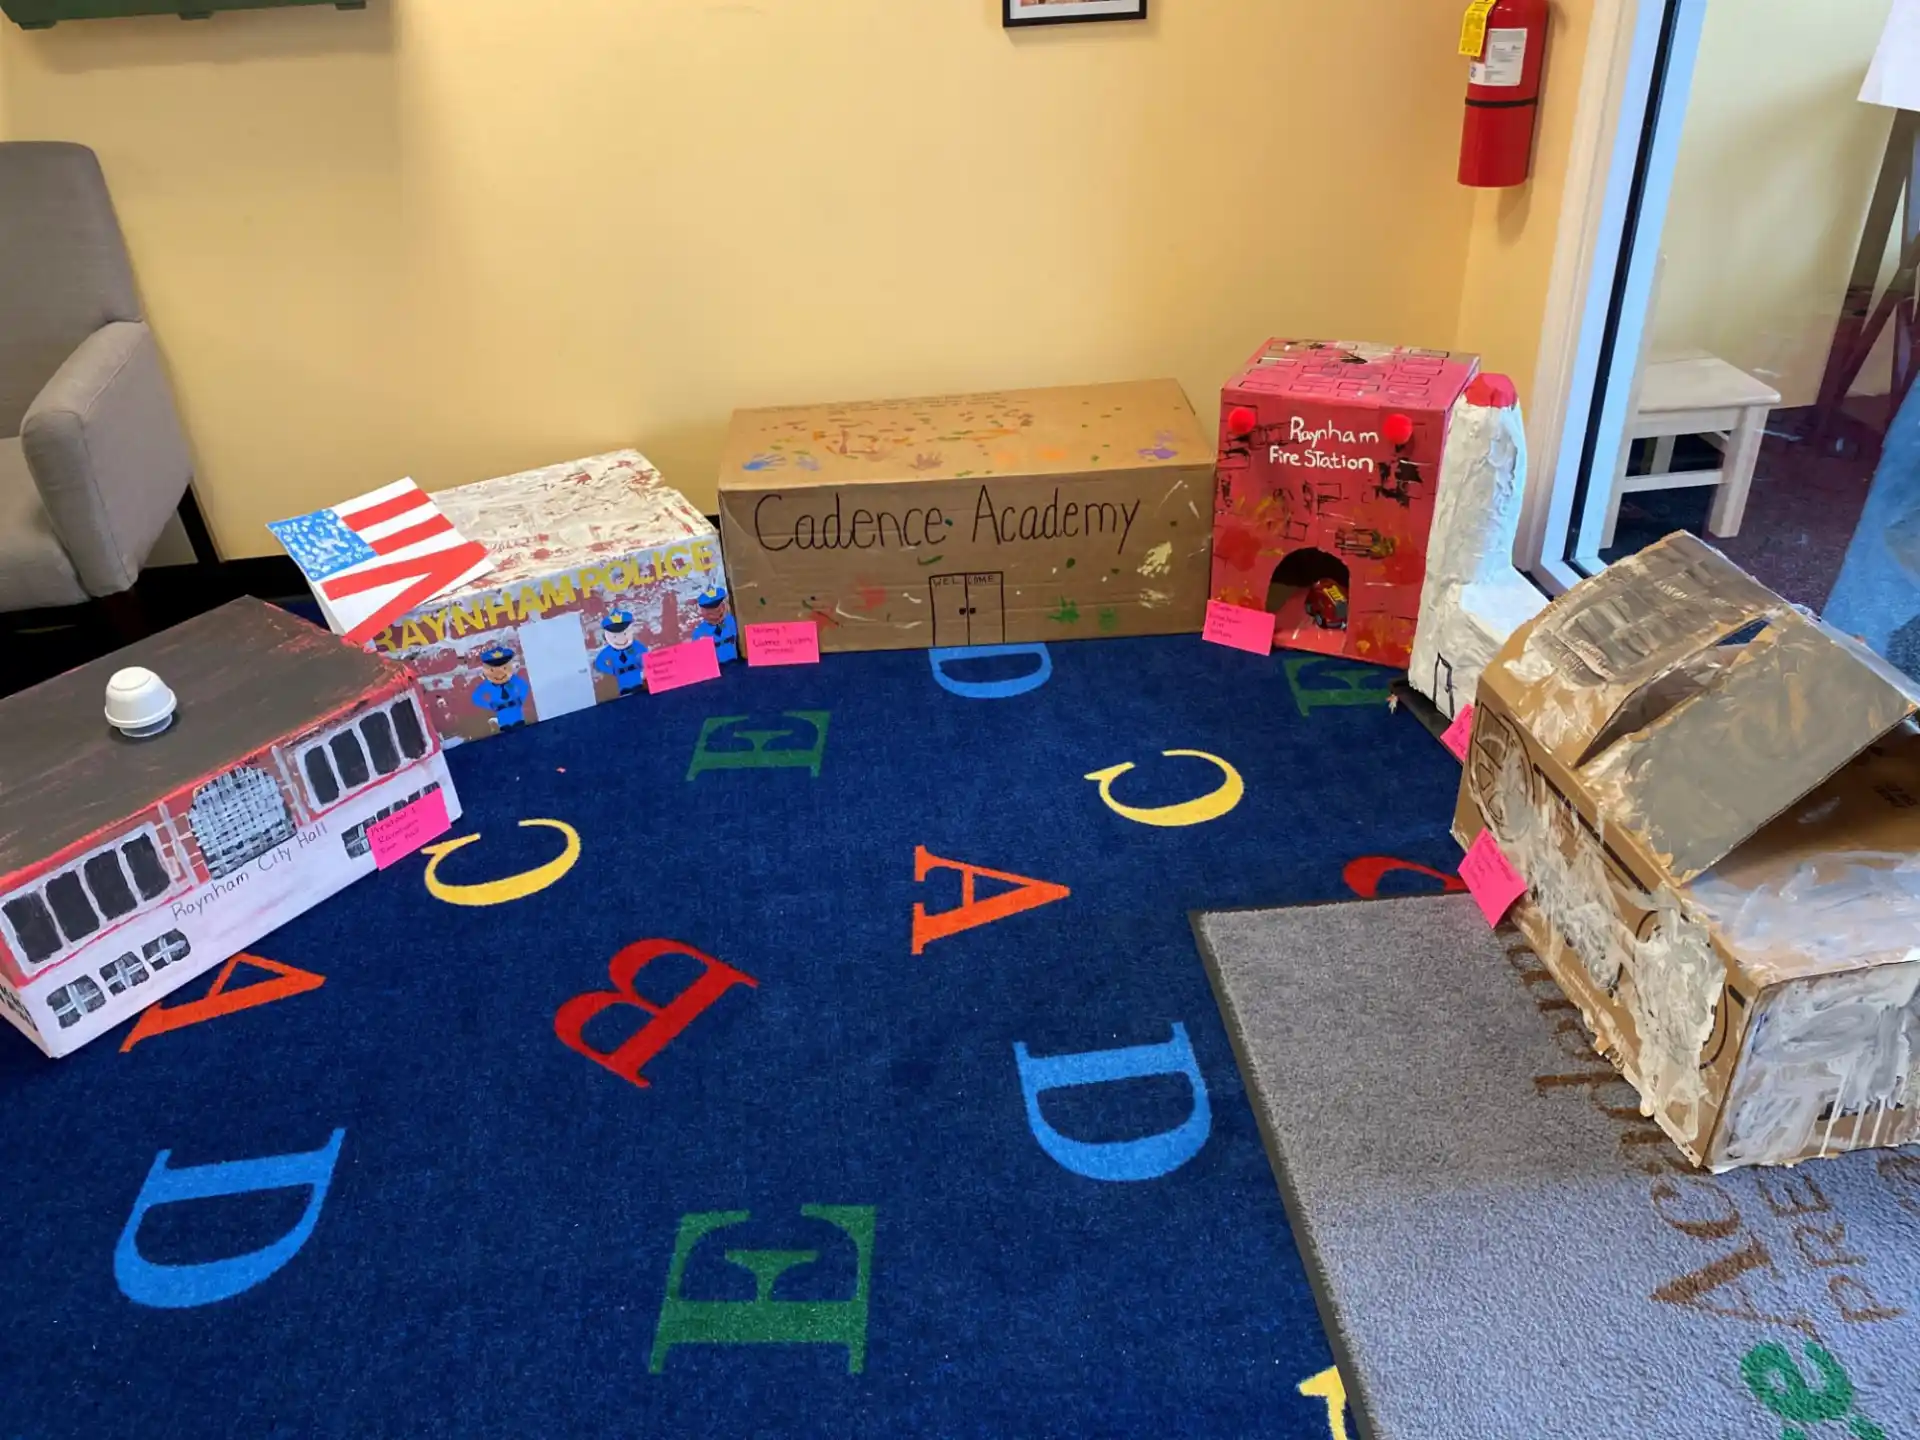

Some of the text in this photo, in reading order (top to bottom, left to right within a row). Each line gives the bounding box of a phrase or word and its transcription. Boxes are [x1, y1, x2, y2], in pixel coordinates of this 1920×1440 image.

[1269, 445, 1301, 467] Fire
[1289, 416, 1380, 448] Raynham
[754, 484, 1141, 554] Cadence Academy
[374, 540, 717, 653] RAYNHAM POLICE
[171, 821, 329, 920] Raynham City Hall
